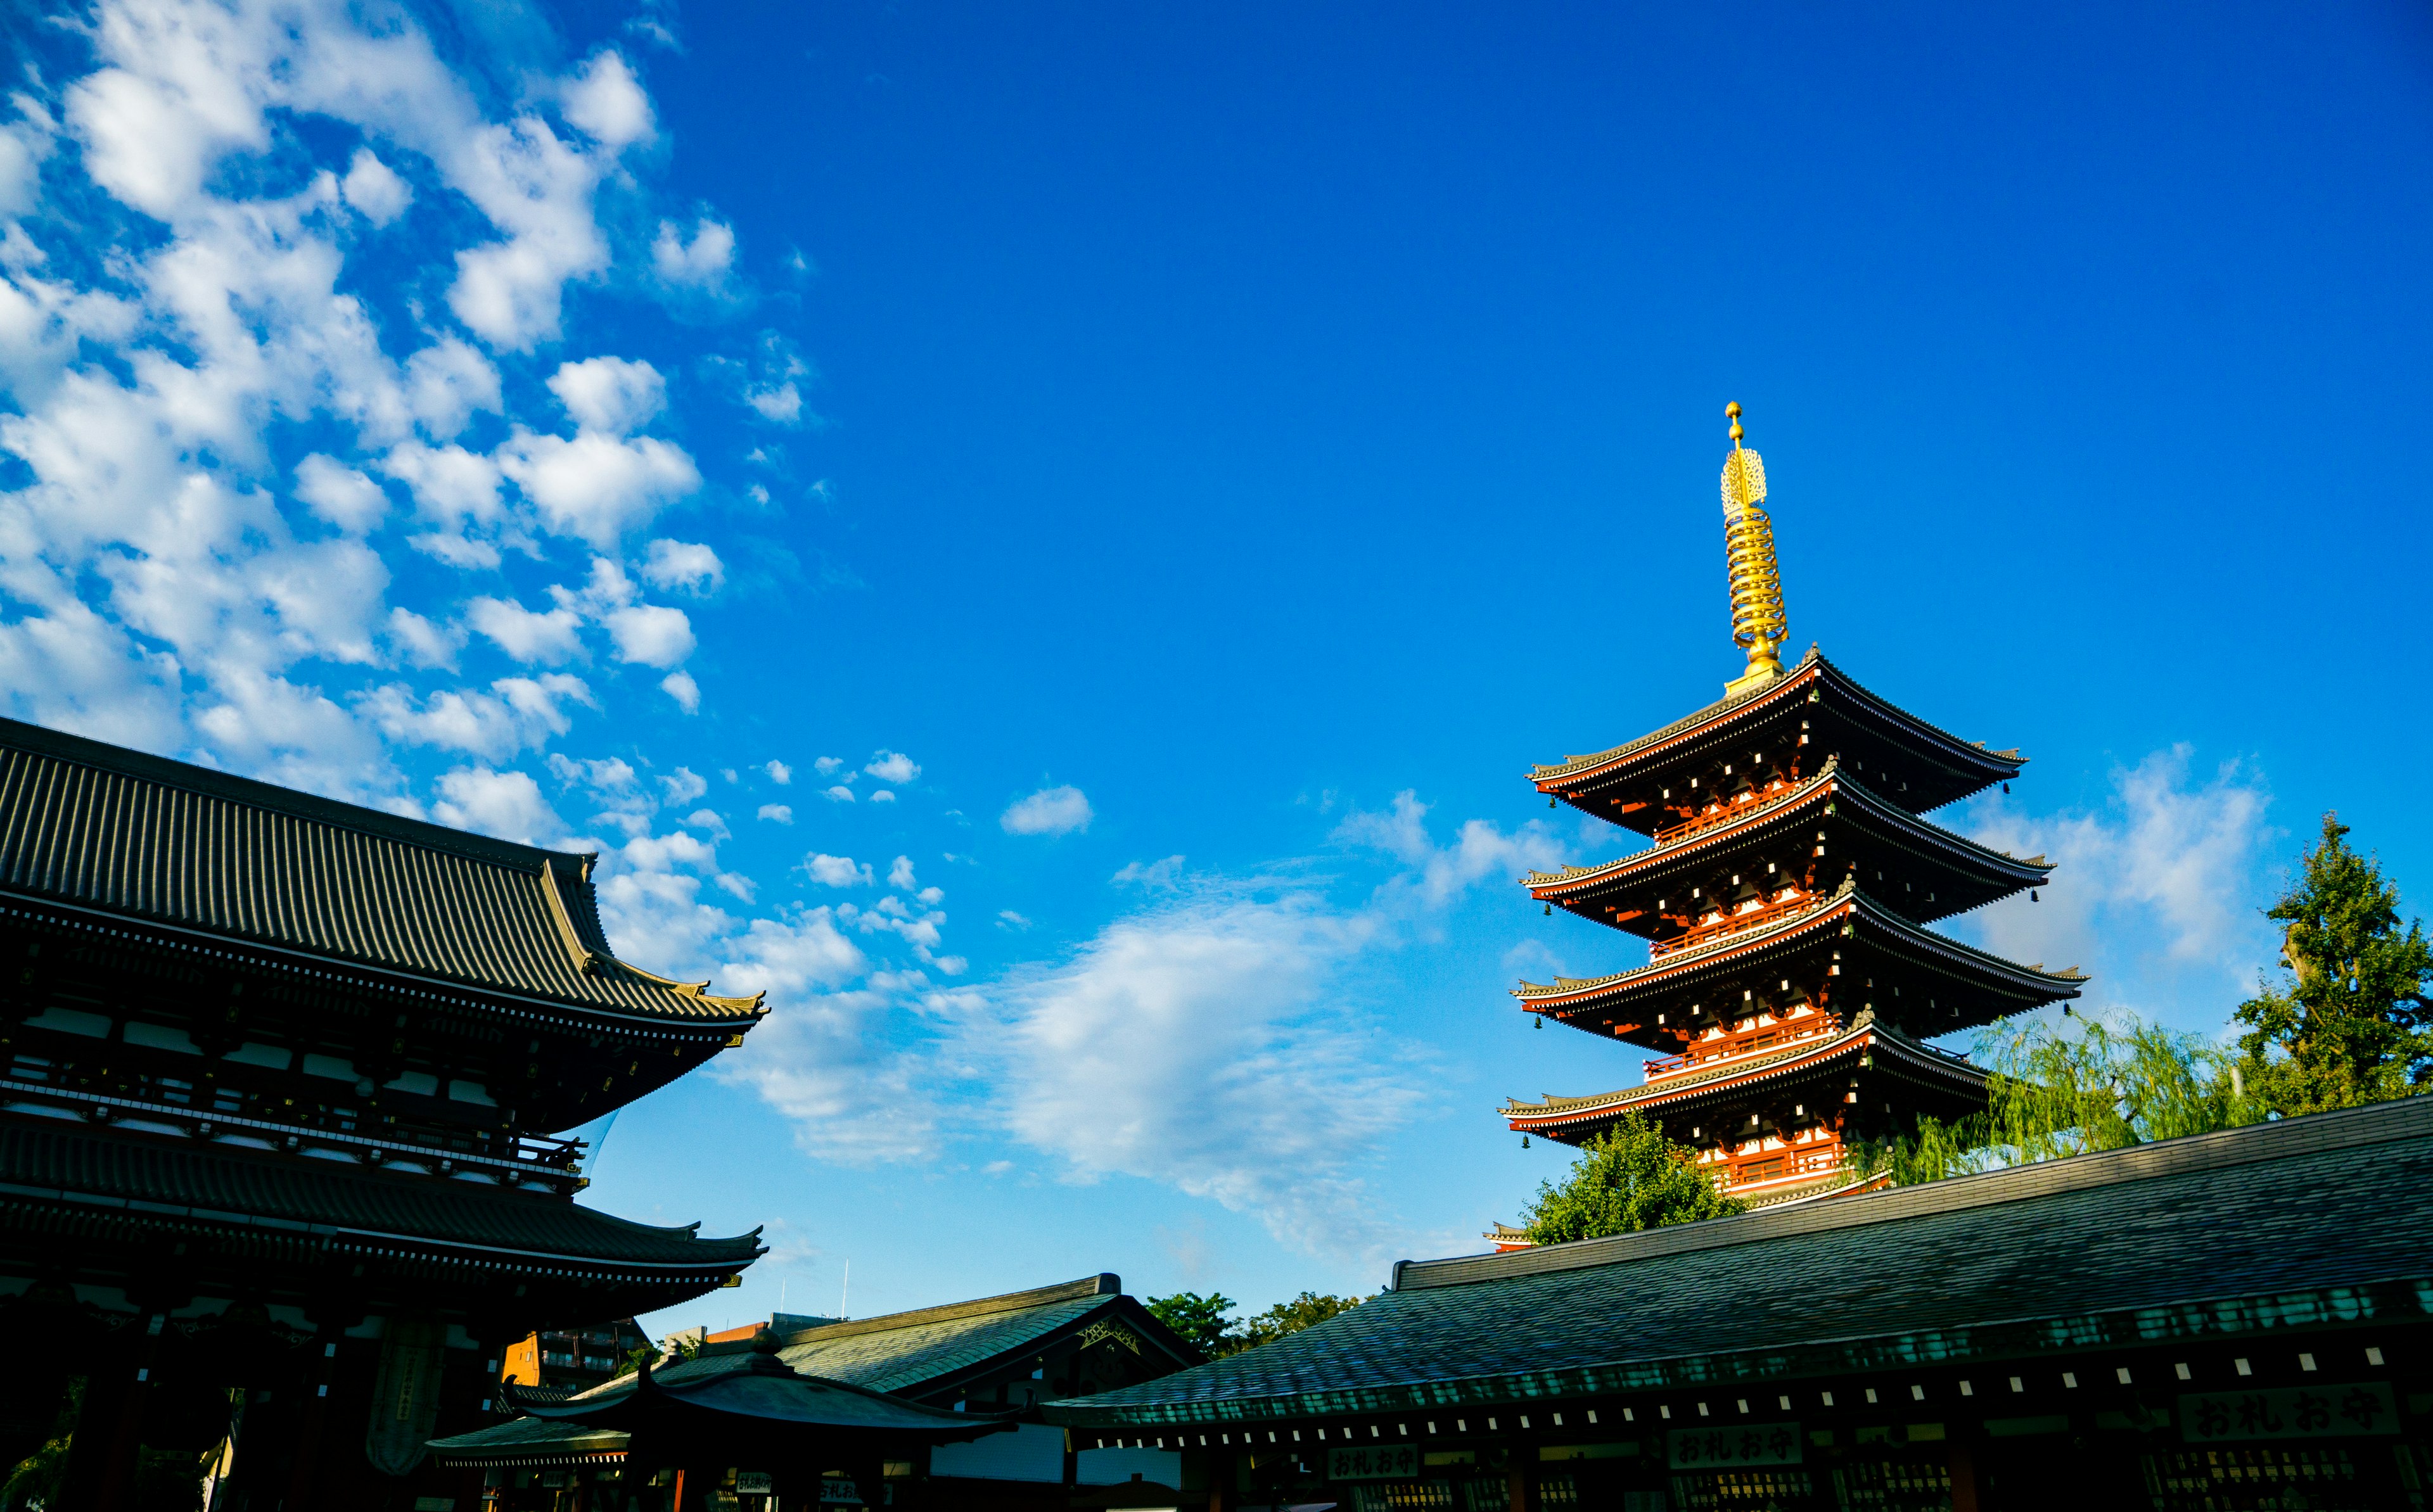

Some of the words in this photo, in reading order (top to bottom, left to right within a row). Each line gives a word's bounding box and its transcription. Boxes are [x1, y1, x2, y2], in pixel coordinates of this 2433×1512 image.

[2195, 1387, 2384, 1438] お札お守
[1335, 1446, 1414, 1477] お札お守
[1678, 1427, 1794, 1463] お札お守
